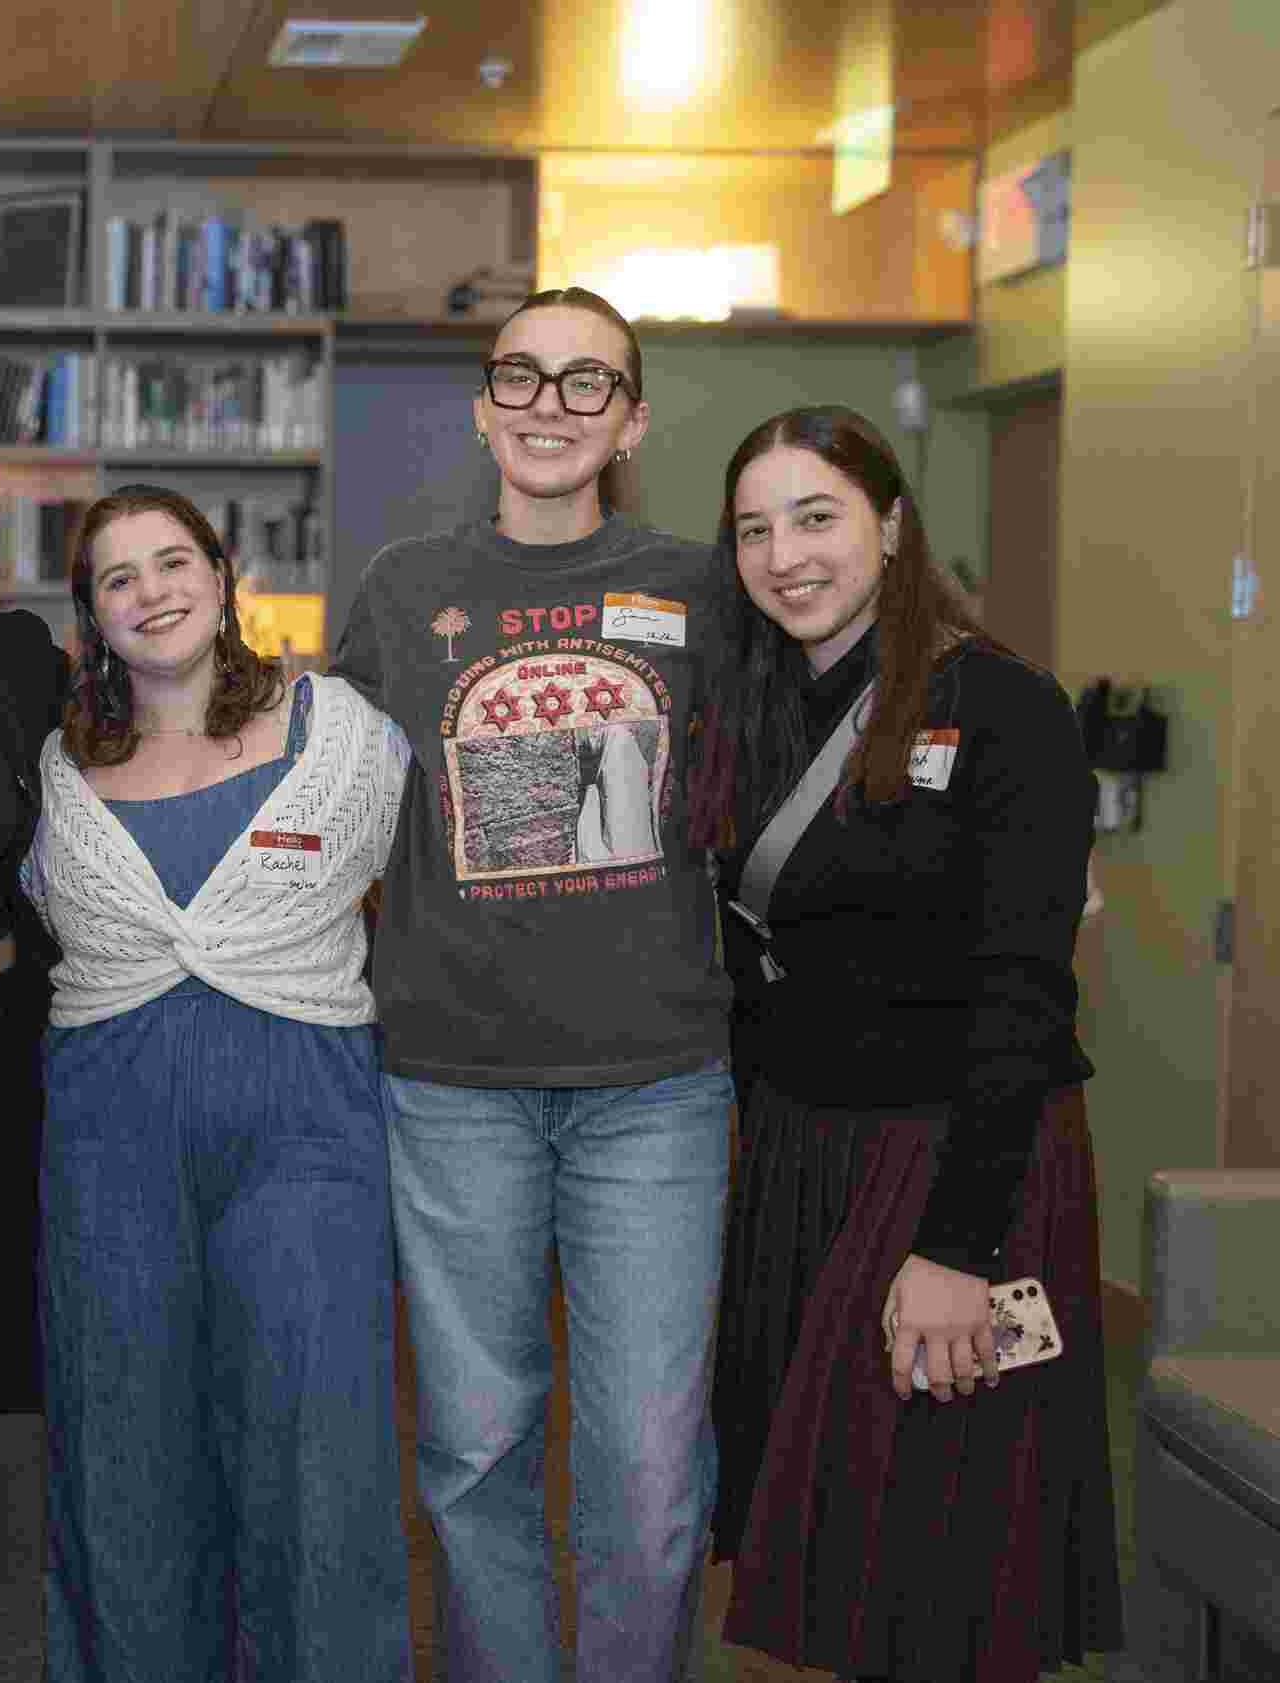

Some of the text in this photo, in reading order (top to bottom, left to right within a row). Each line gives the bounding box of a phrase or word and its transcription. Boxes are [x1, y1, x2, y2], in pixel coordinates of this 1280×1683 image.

[501, 604, 600, 635] STOP
[517, 662, 586, 680] ONLINE
[258, 851, 306, 872] Rachel
[469, 878, 545, 898] PROTECT
[553, 871, 598, 895] YOUR
